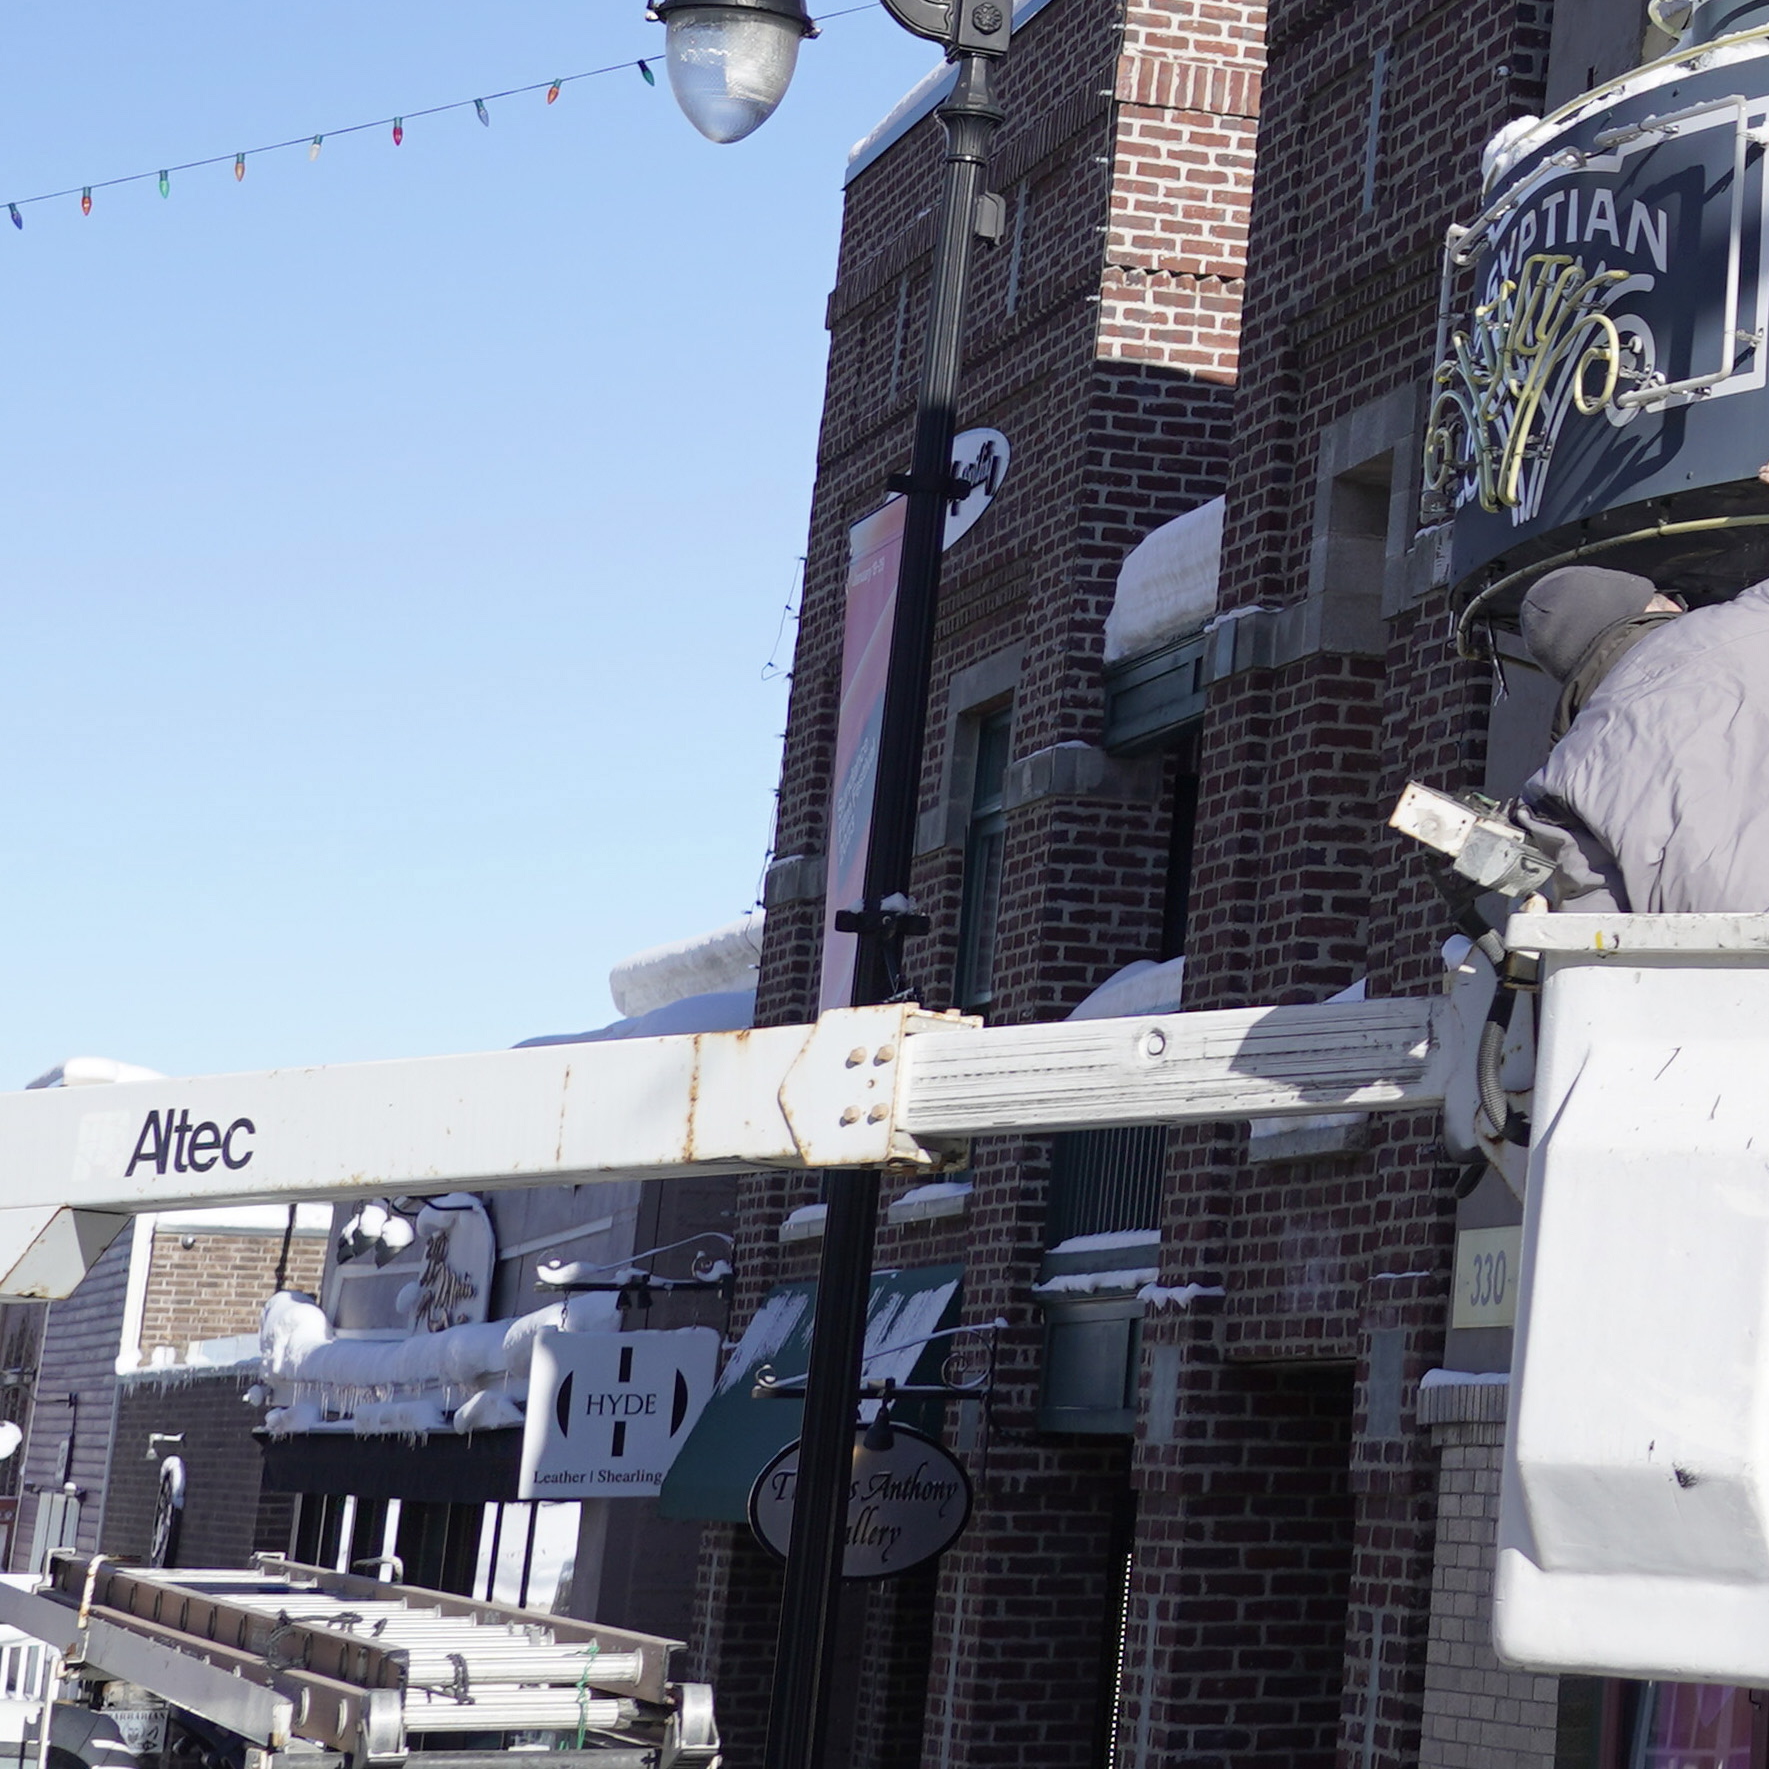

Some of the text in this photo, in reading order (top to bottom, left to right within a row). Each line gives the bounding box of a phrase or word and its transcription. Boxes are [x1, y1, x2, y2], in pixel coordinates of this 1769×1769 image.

[123, 1108, 256, 1177] Altec
[1470, 1249, 1507, 1307] 330
[586, 1393, 657, 1415] HYDE
[533, 1470, 586, 1484] Leather
[597, 1469, 663, 1486] Shearling
[861, 1461, 960, 1518] Anthony
